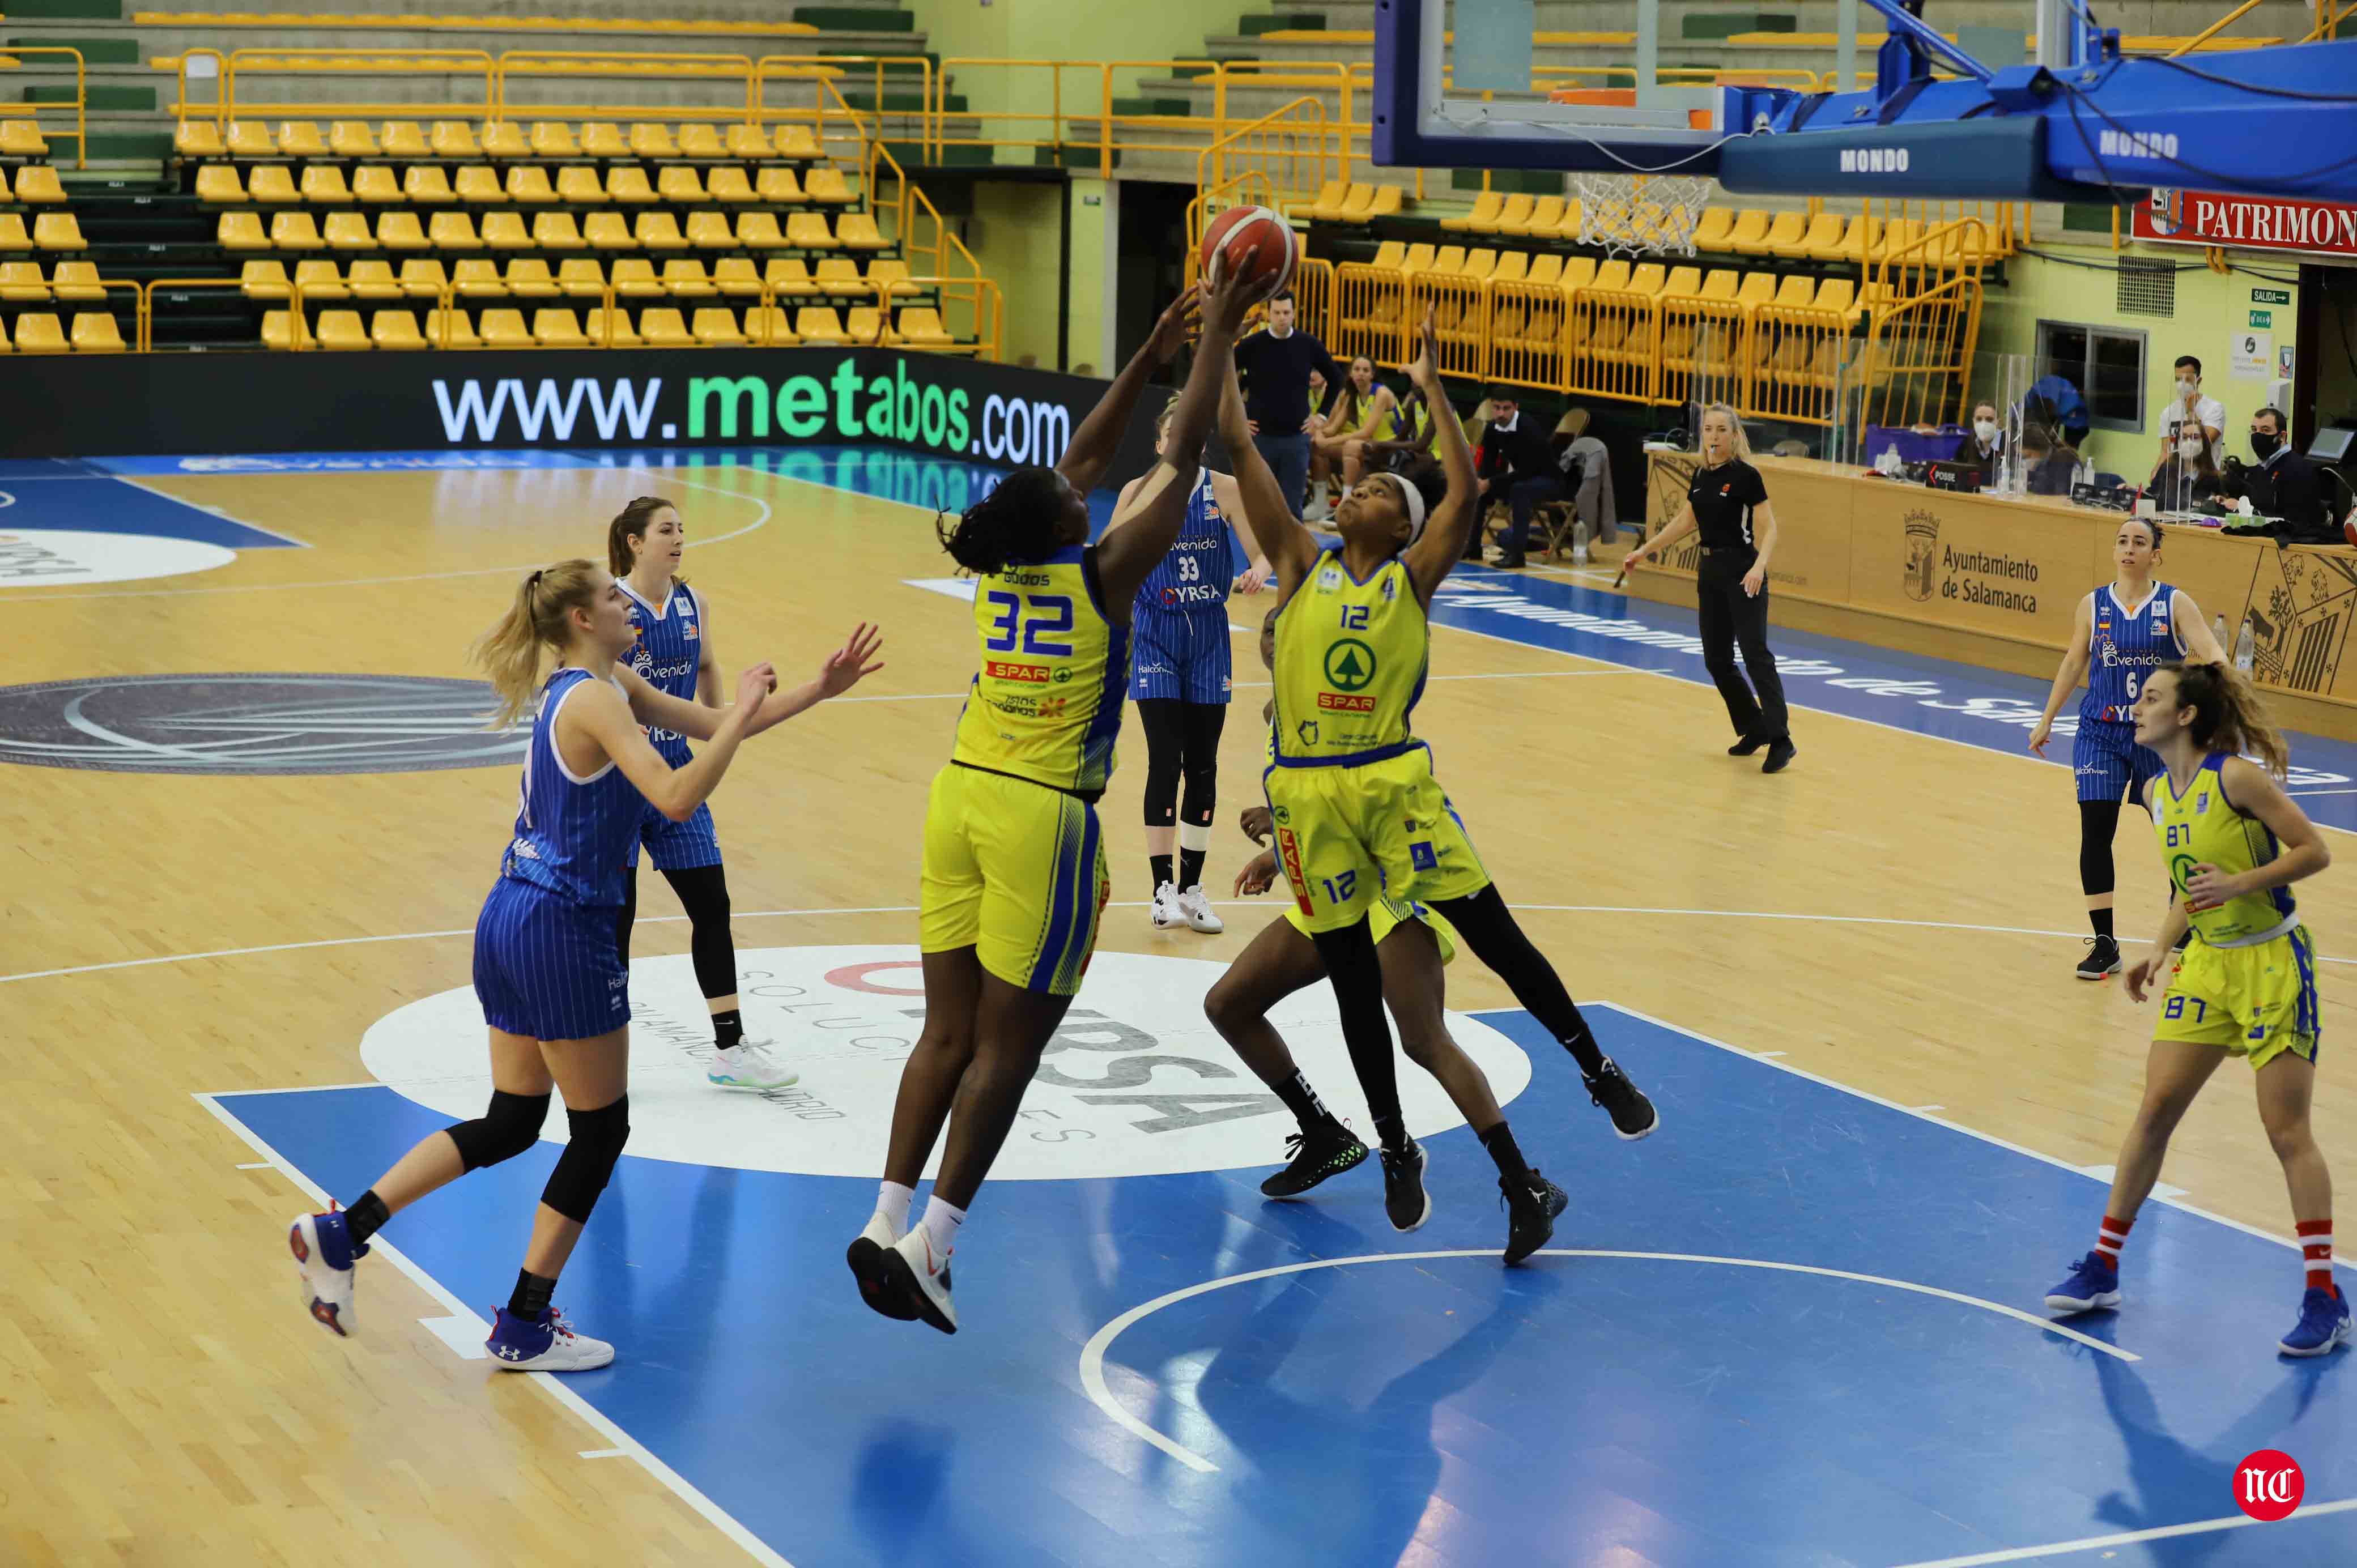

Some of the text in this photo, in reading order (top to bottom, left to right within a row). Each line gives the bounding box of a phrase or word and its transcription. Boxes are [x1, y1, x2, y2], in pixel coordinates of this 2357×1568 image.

[2100, 130, 2178, 160] MONDO
[1840, 148, 1909, 173] MONDO
[2254, 291, 2276, 302] SALIDA
[1178, 556, 1199, 581] 33
[1943, 544, 2039, 582] Ayuntamiento
[1942, 575, 2037, 613] de Salamanca
[986, 590, 1073, 657] 32
[1341, 604, 1370, 630] 12
[995, 664, 1049, 680] SPAR
[2126, 672, 2138, 698] 6
[1320, 695, 1374, 709] SPAR
[2166, 823, 2190, 847] 87
[1280, 830, 1306, 897] SPAR
[1322, 870, 1356, 904] 12
[2164, 995, 2207, 1024] 87
